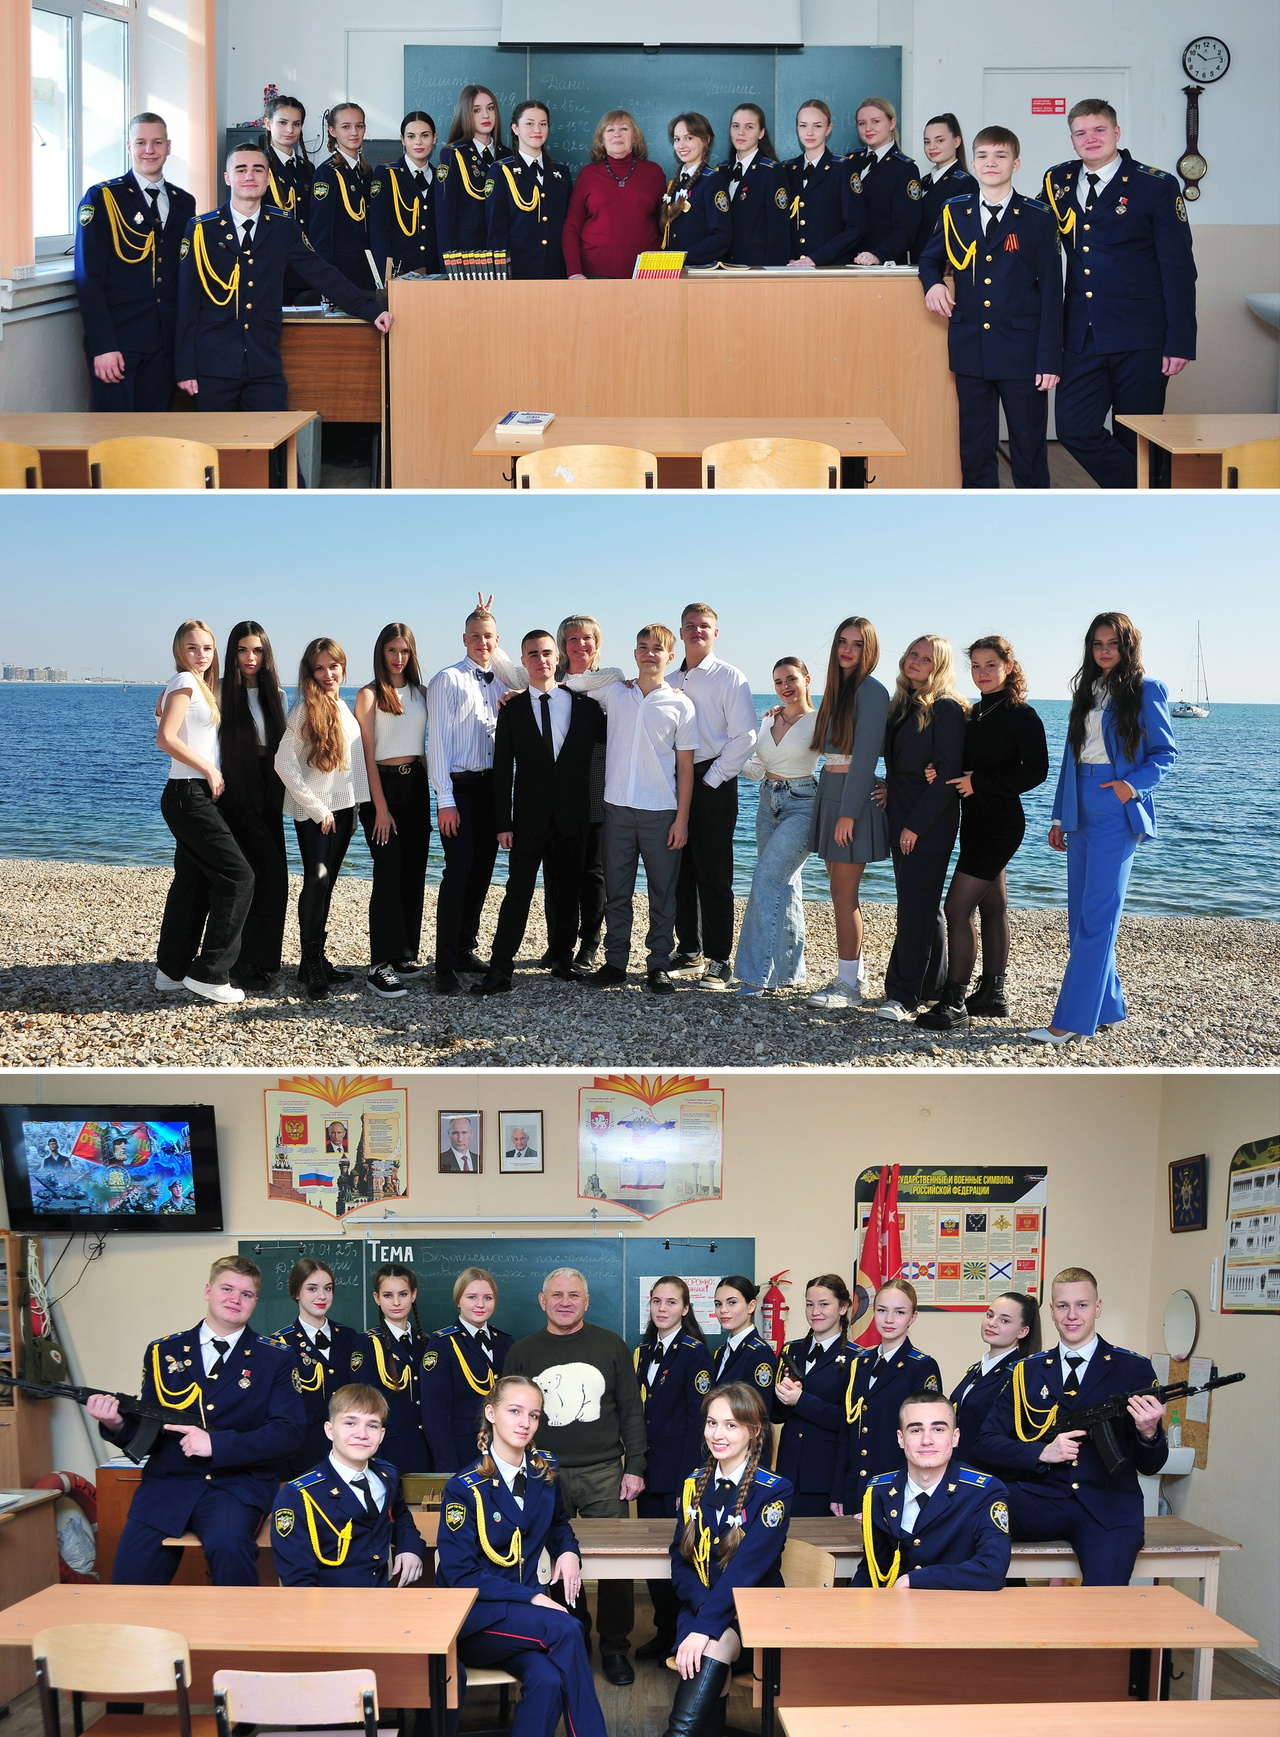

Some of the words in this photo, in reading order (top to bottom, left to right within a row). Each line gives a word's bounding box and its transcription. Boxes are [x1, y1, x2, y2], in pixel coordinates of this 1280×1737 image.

[887, 1175, 947, 1185] ГСУДАРСТВЕННЫЕ
[948, 1175, 953, 1184] И
[954, 1175, 982, 1184] ВОЕННЫЕ
[983, 1175, 1014, 1185] СИМВОЛЫ
[912, 1184, 951, 1195] РОССИЙСКОЙ
[952, 1185, 990, 1196] ФЕДЕРАЦИИ
